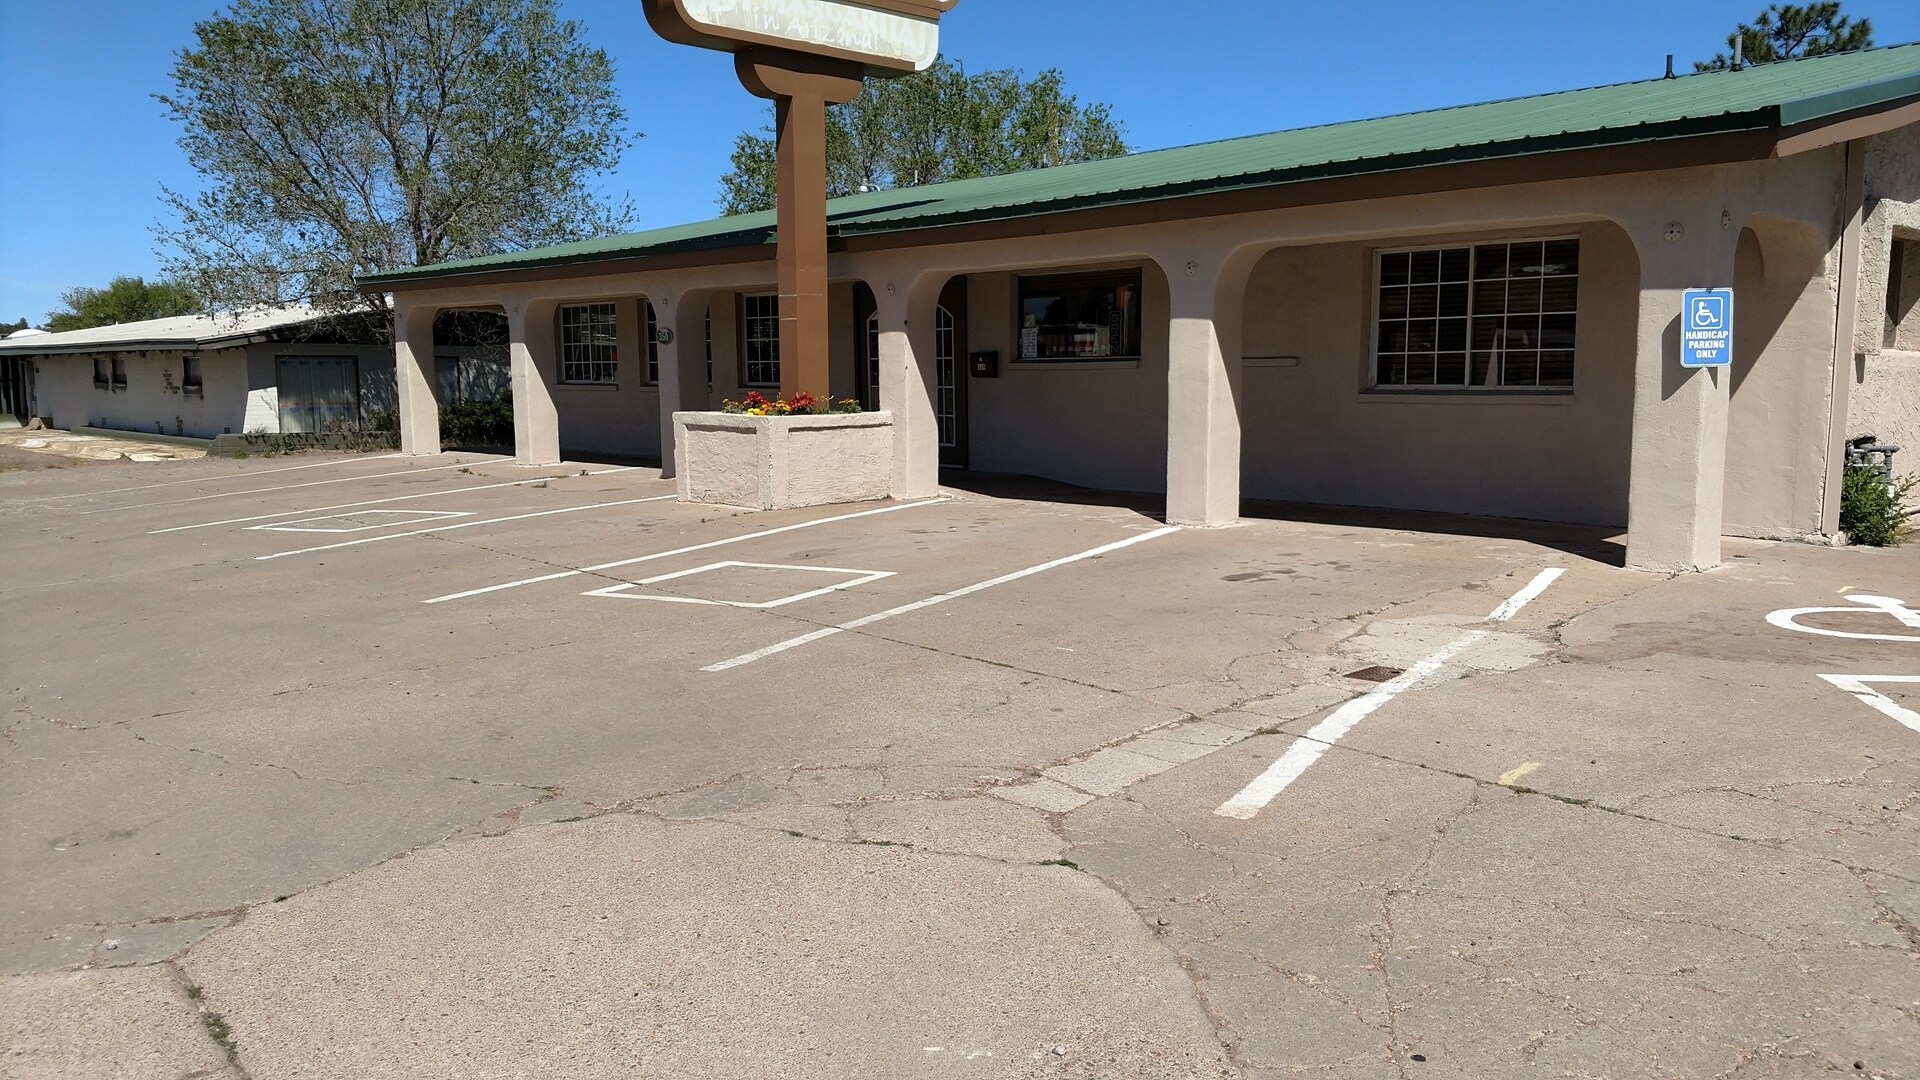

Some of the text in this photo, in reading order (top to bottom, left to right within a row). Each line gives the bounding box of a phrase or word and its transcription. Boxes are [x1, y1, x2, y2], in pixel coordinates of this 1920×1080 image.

[1110, 313, 1120, 356] OPEN
[1685, 330, 1729, 340] HANDICAP
[1688, 340, 1725, 349] PARKING
[1695, 349, 1718, 359] ONLY
